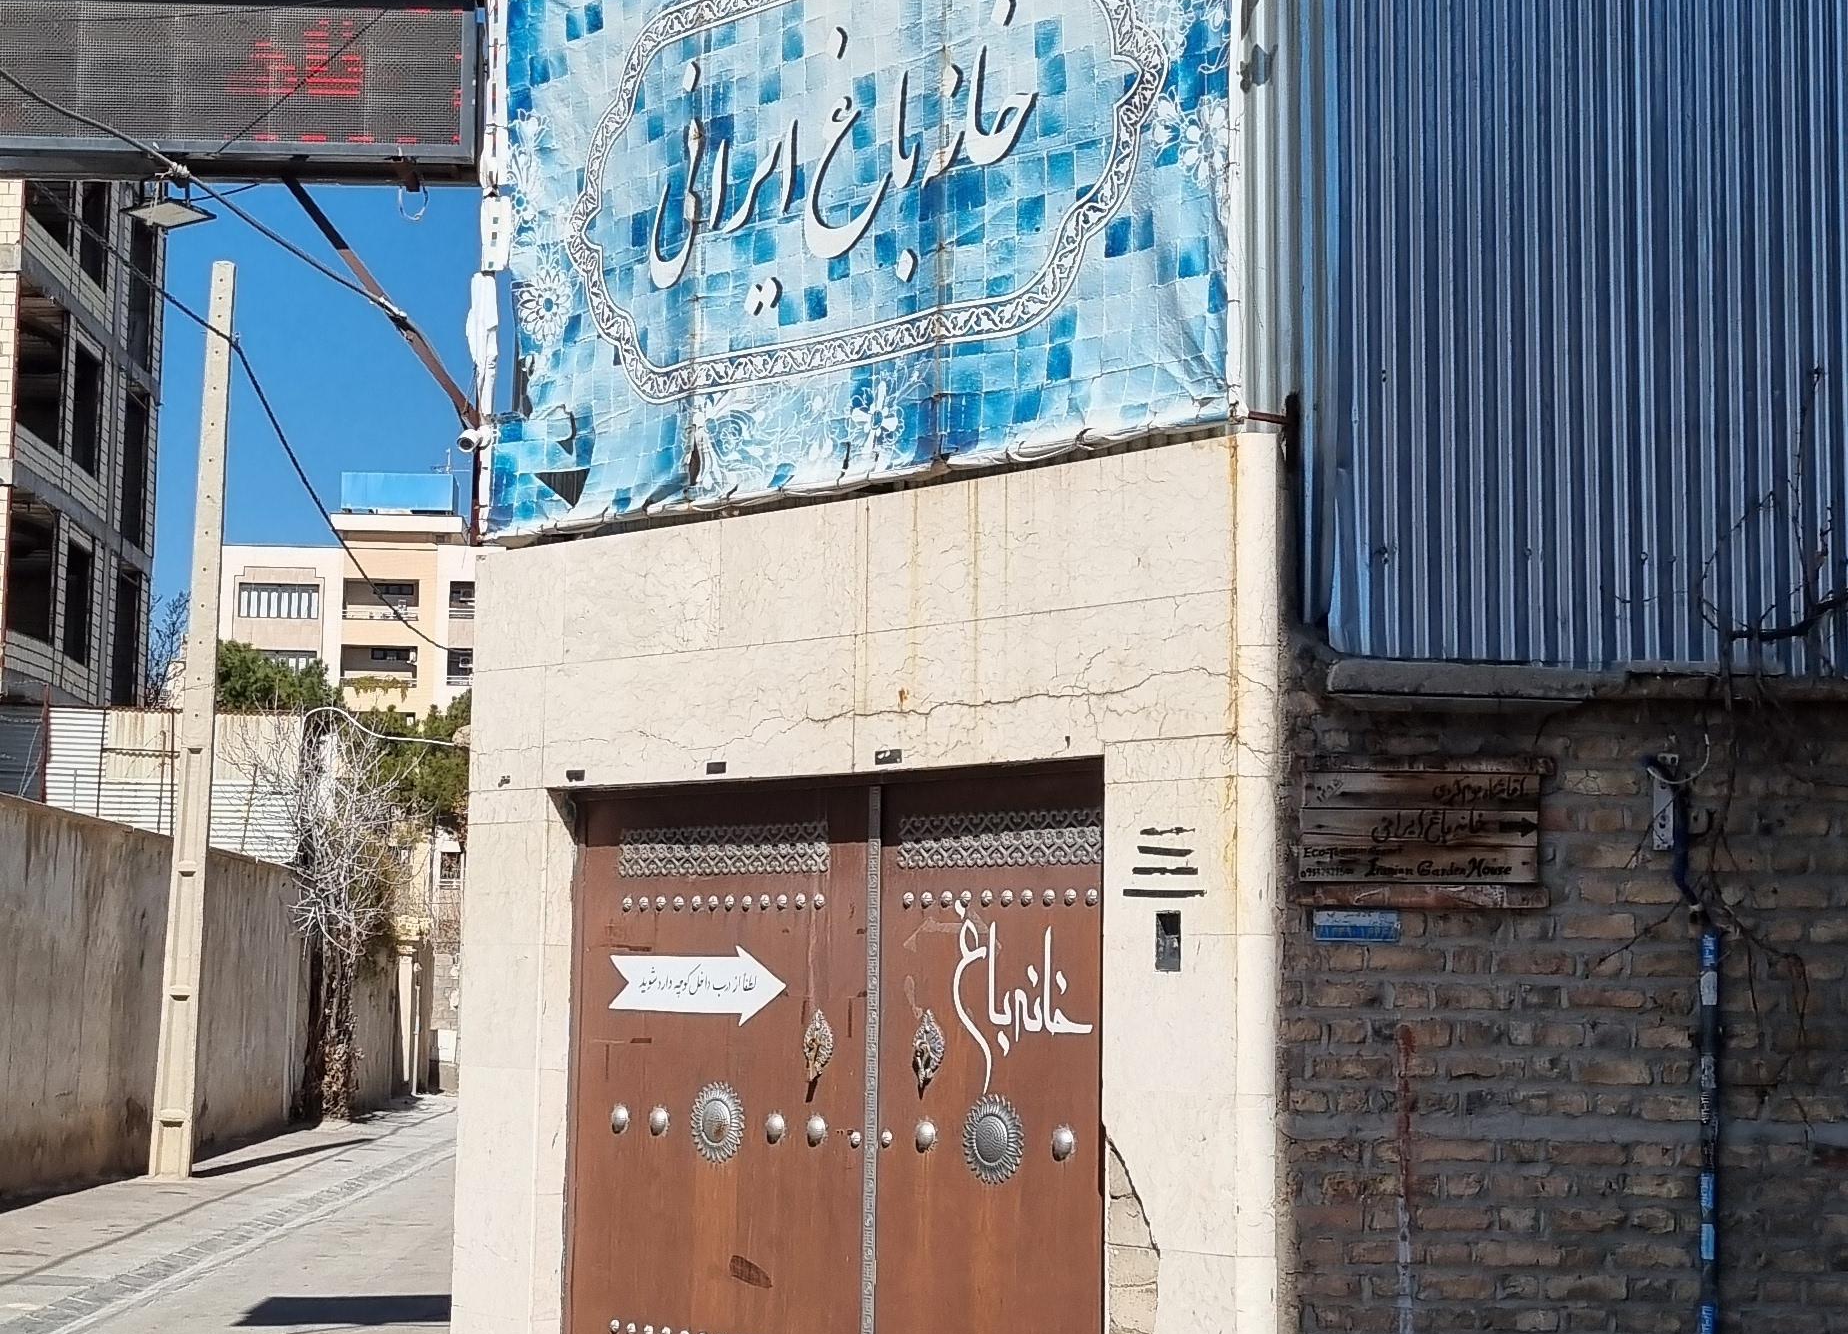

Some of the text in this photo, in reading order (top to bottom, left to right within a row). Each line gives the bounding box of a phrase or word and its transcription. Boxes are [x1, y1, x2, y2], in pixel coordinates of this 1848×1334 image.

[805, 27, 919, 283] باغ
[650, 62, 798, 316] ایرانی
[1371, 809, 1488, 843] خانه باغ ایرانی
[1416, 860, 1467, 877] Garden
[1466, 857, 1513, 878] House
[638, 966, 658, 994] شوید
[657, 975, 673, 991] وارد
[674, 963, 701, 998] کوچه
[689, 971, 711, 995] داخل
[712, 981, 731, 997] درب
[732, 975, 741, 993] از
[953, 899, 1094, 1095] خانه باغ
